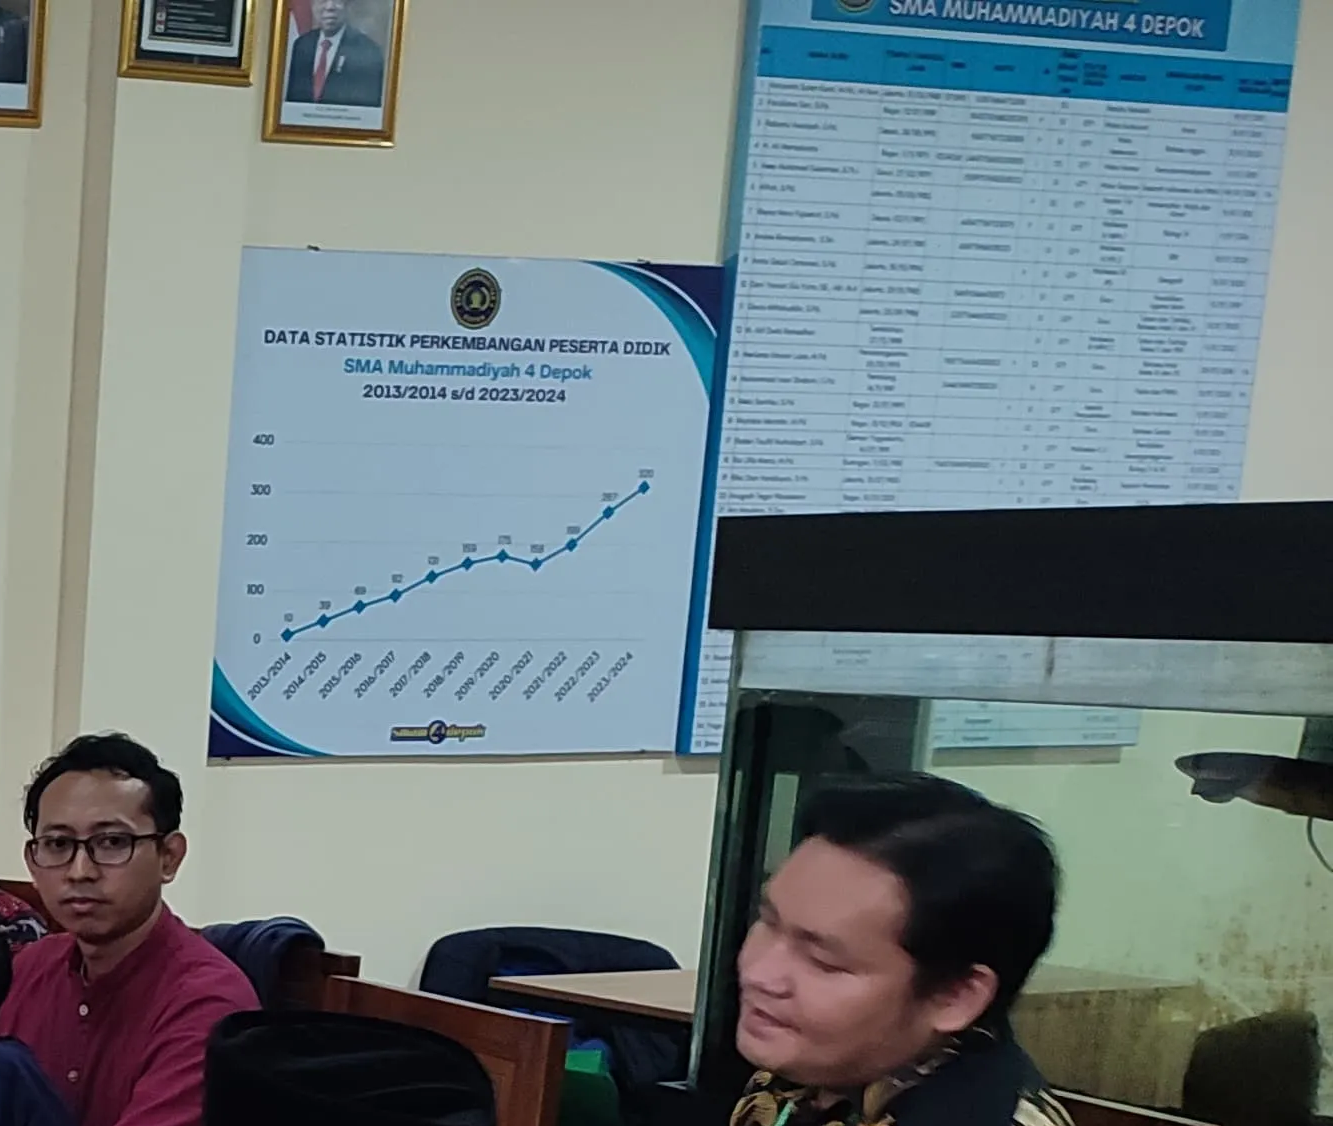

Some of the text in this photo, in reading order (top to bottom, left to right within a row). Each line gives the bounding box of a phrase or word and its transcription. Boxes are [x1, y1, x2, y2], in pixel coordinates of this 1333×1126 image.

[889, 0, 1205, 38] SMA MUHAMMADIYAH 4 DEPOK
[264, 329, 671, 356] DATA STATISTIK PERKEMBANGAN PESERTA DIDIK
[343, 358, 593, 383] SMA Muhammadiyah 4 Depok
[362, 384, 566, 402] 2013/2014 s/d 2023/2024
[252, 434, 275, 445] 400
[250, 484, 271, 495] 300
[246, 534, 268, 545] 200
[247, 584, 265, 595] 100
[253, 633, 261, 644] 0
[247, 652, 291, 701] 2013/2014
[282, 651, 326, 700] 2014/2015
[318, 652, 362, 700] 2015/2016
[354, 650, 395, 698] 2016/2017
[389, 651, 431, 697] 2017/2018
[422, 651, 464, 698] 2018/2019
[454, 651, 499, 701] 2019/2020
[488, 650, 533, 700] 2020/2021
[522, 650, 567, 700] 2021/2022
[554, 650, 600, 702] 2022/2023
[587, 651, 633, 702] 2023/2024
